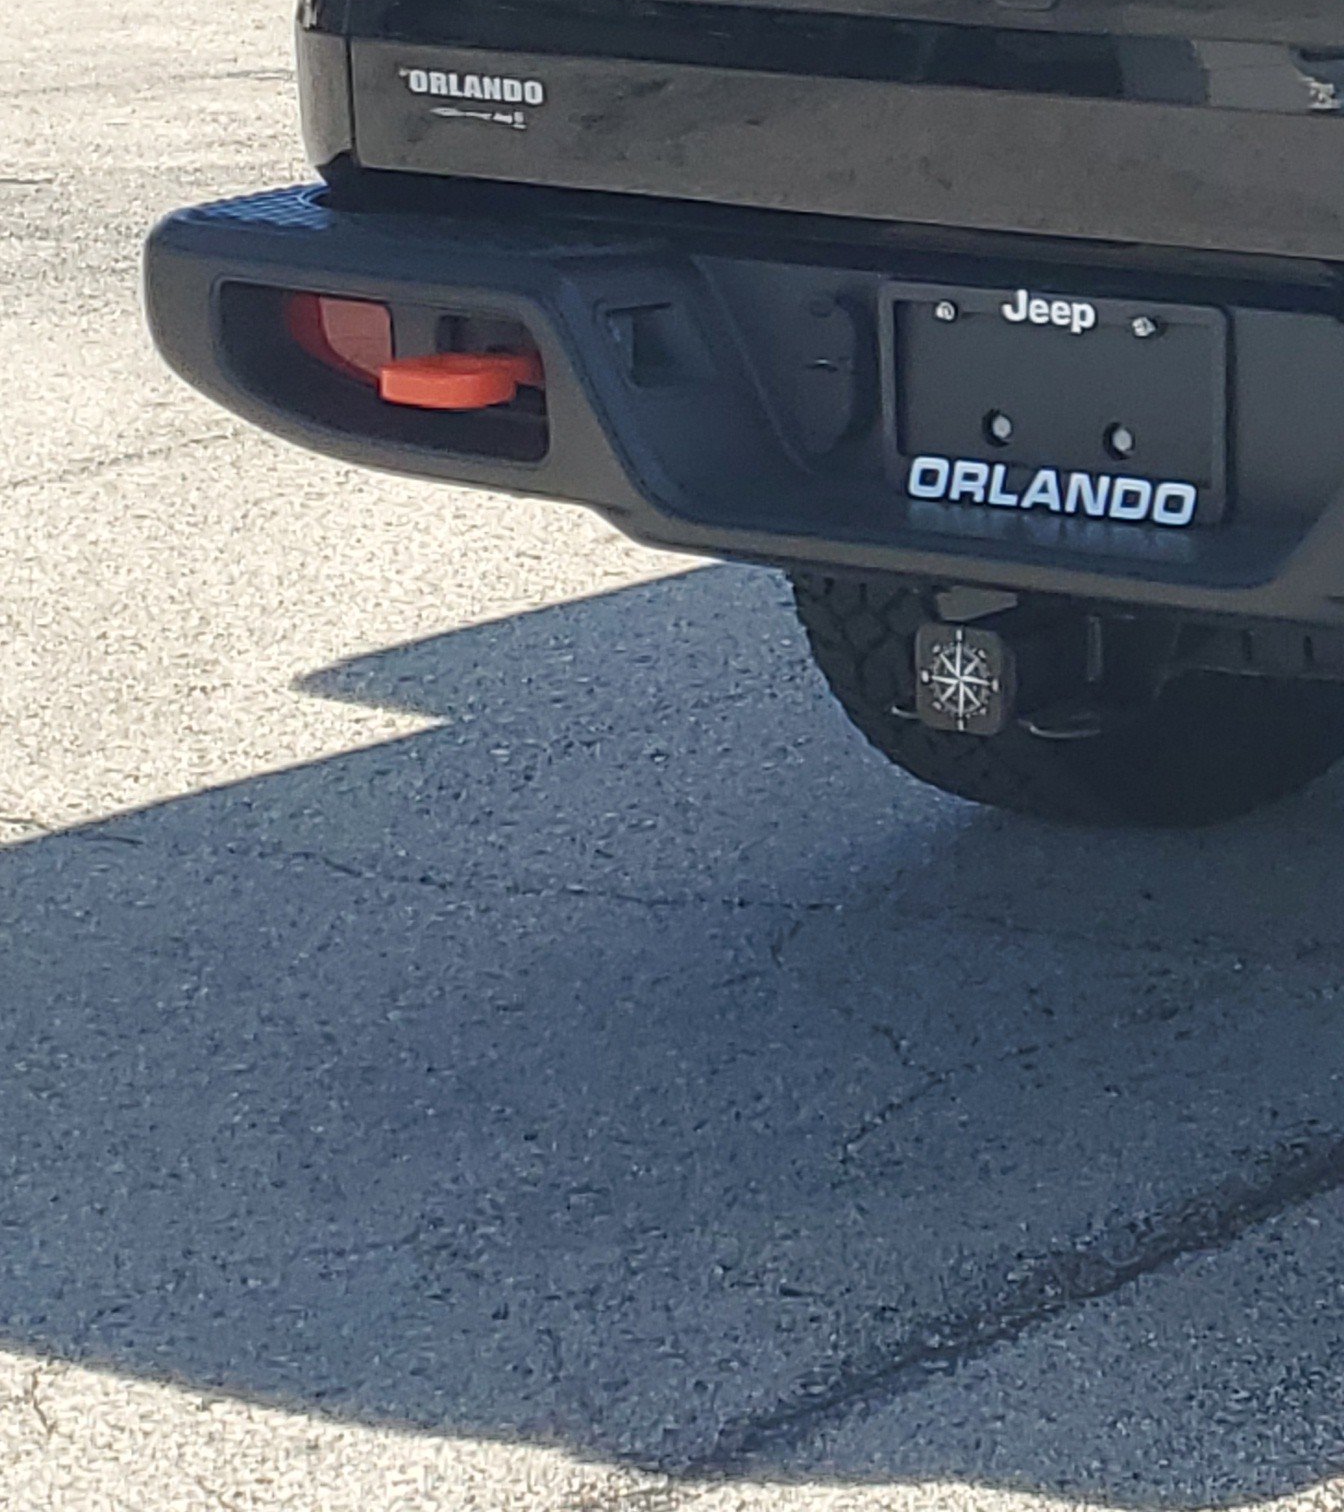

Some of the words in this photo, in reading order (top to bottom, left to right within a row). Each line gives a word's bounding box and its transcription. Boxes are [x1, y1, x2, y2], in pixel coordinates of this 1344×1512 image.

[409, 69, 544, 105] ORLANDO
[1002, 288, 1096, 334] Jeep
[908, 456, 1197, 526] ORLANDO
